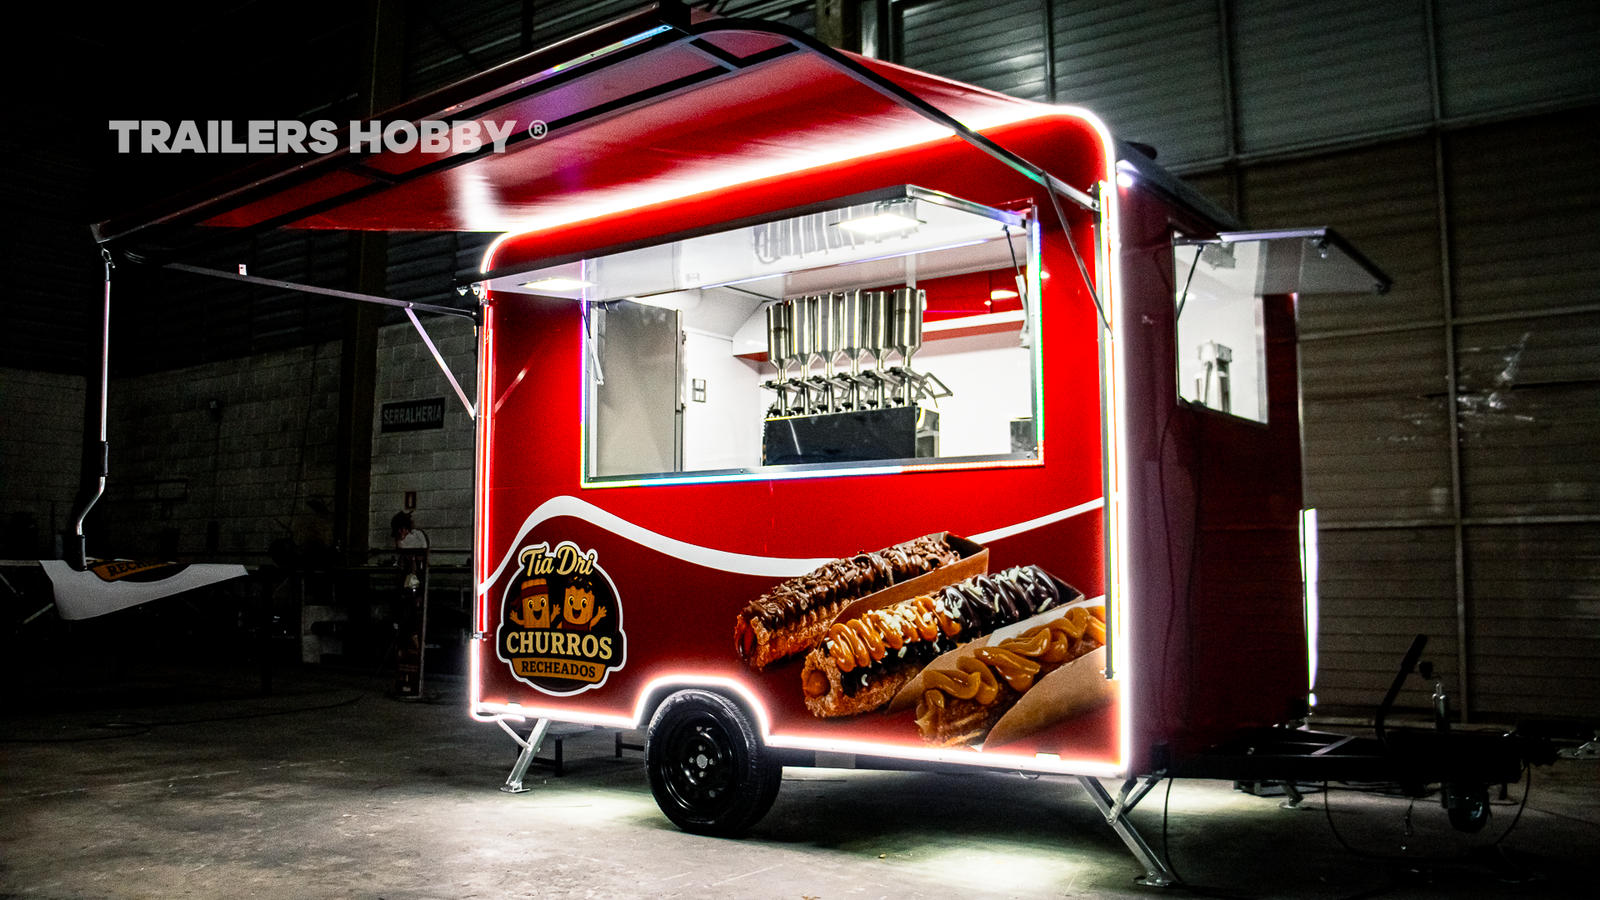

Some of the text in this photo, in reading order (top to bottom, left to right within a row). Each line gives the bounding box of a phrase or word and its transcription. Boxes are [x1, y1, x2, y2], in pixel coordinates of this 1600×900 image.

[383, 405, 442, 424] SERRALHERIA
[521, 545, 594, 577] Tia Dri
[506, 631, 613, 660] CHURROS
[521, 660, 596, 678] RECHEADOS
